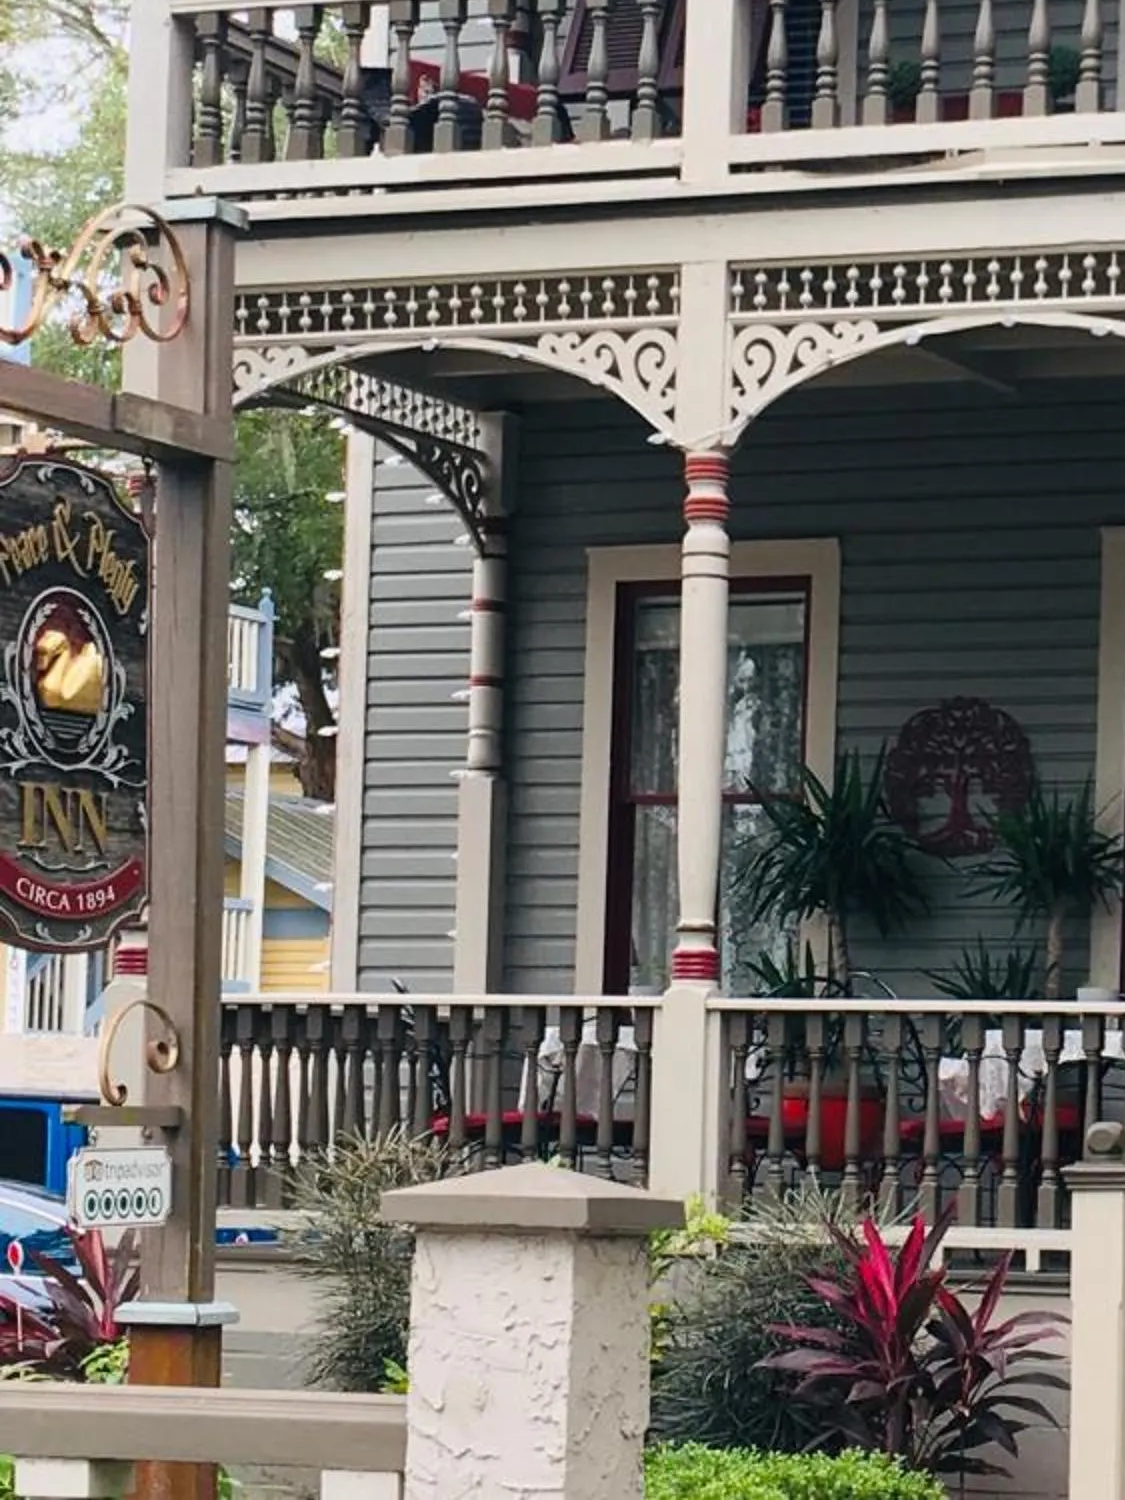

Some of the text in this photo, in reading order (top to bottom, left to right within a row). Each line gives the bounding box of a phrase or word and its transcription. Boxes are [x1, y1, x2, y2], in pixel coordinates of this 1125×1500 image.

[52, 498, 89, 578] &
[83, 511, 139, 615] Plenty
[17, 781, 109, 853] INN
[16, 877, 115, 911] CIRCA 1894
